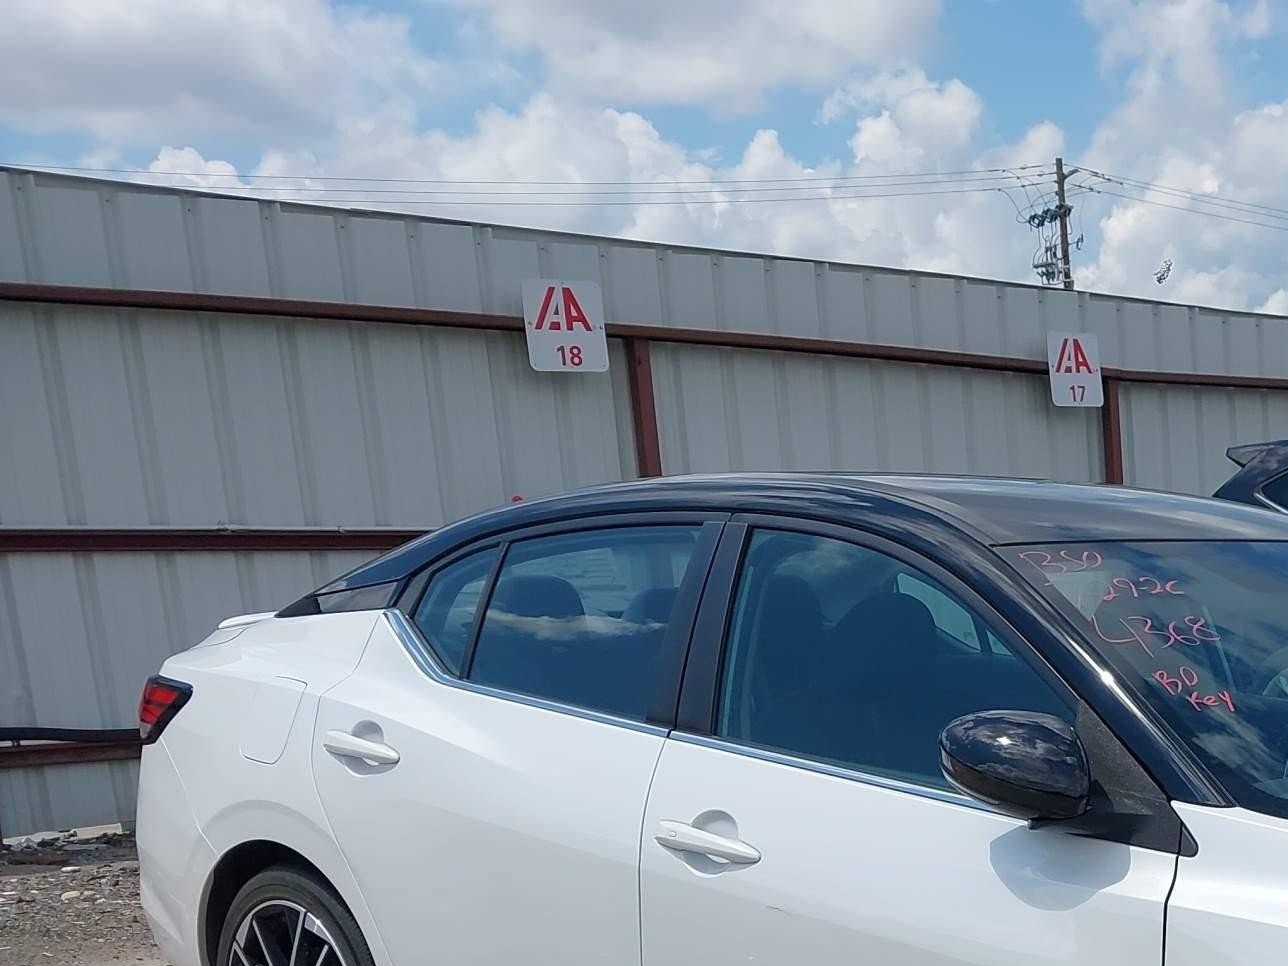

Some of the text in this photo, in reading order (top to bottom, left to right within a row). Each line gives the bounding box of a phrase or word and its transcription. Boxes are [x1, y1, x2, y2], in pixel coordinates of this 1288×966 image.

[556, 345, 583, 366] 18
[1069, 384, 1086, 403] 17
[1091, 615, 1222, 659] 4368
